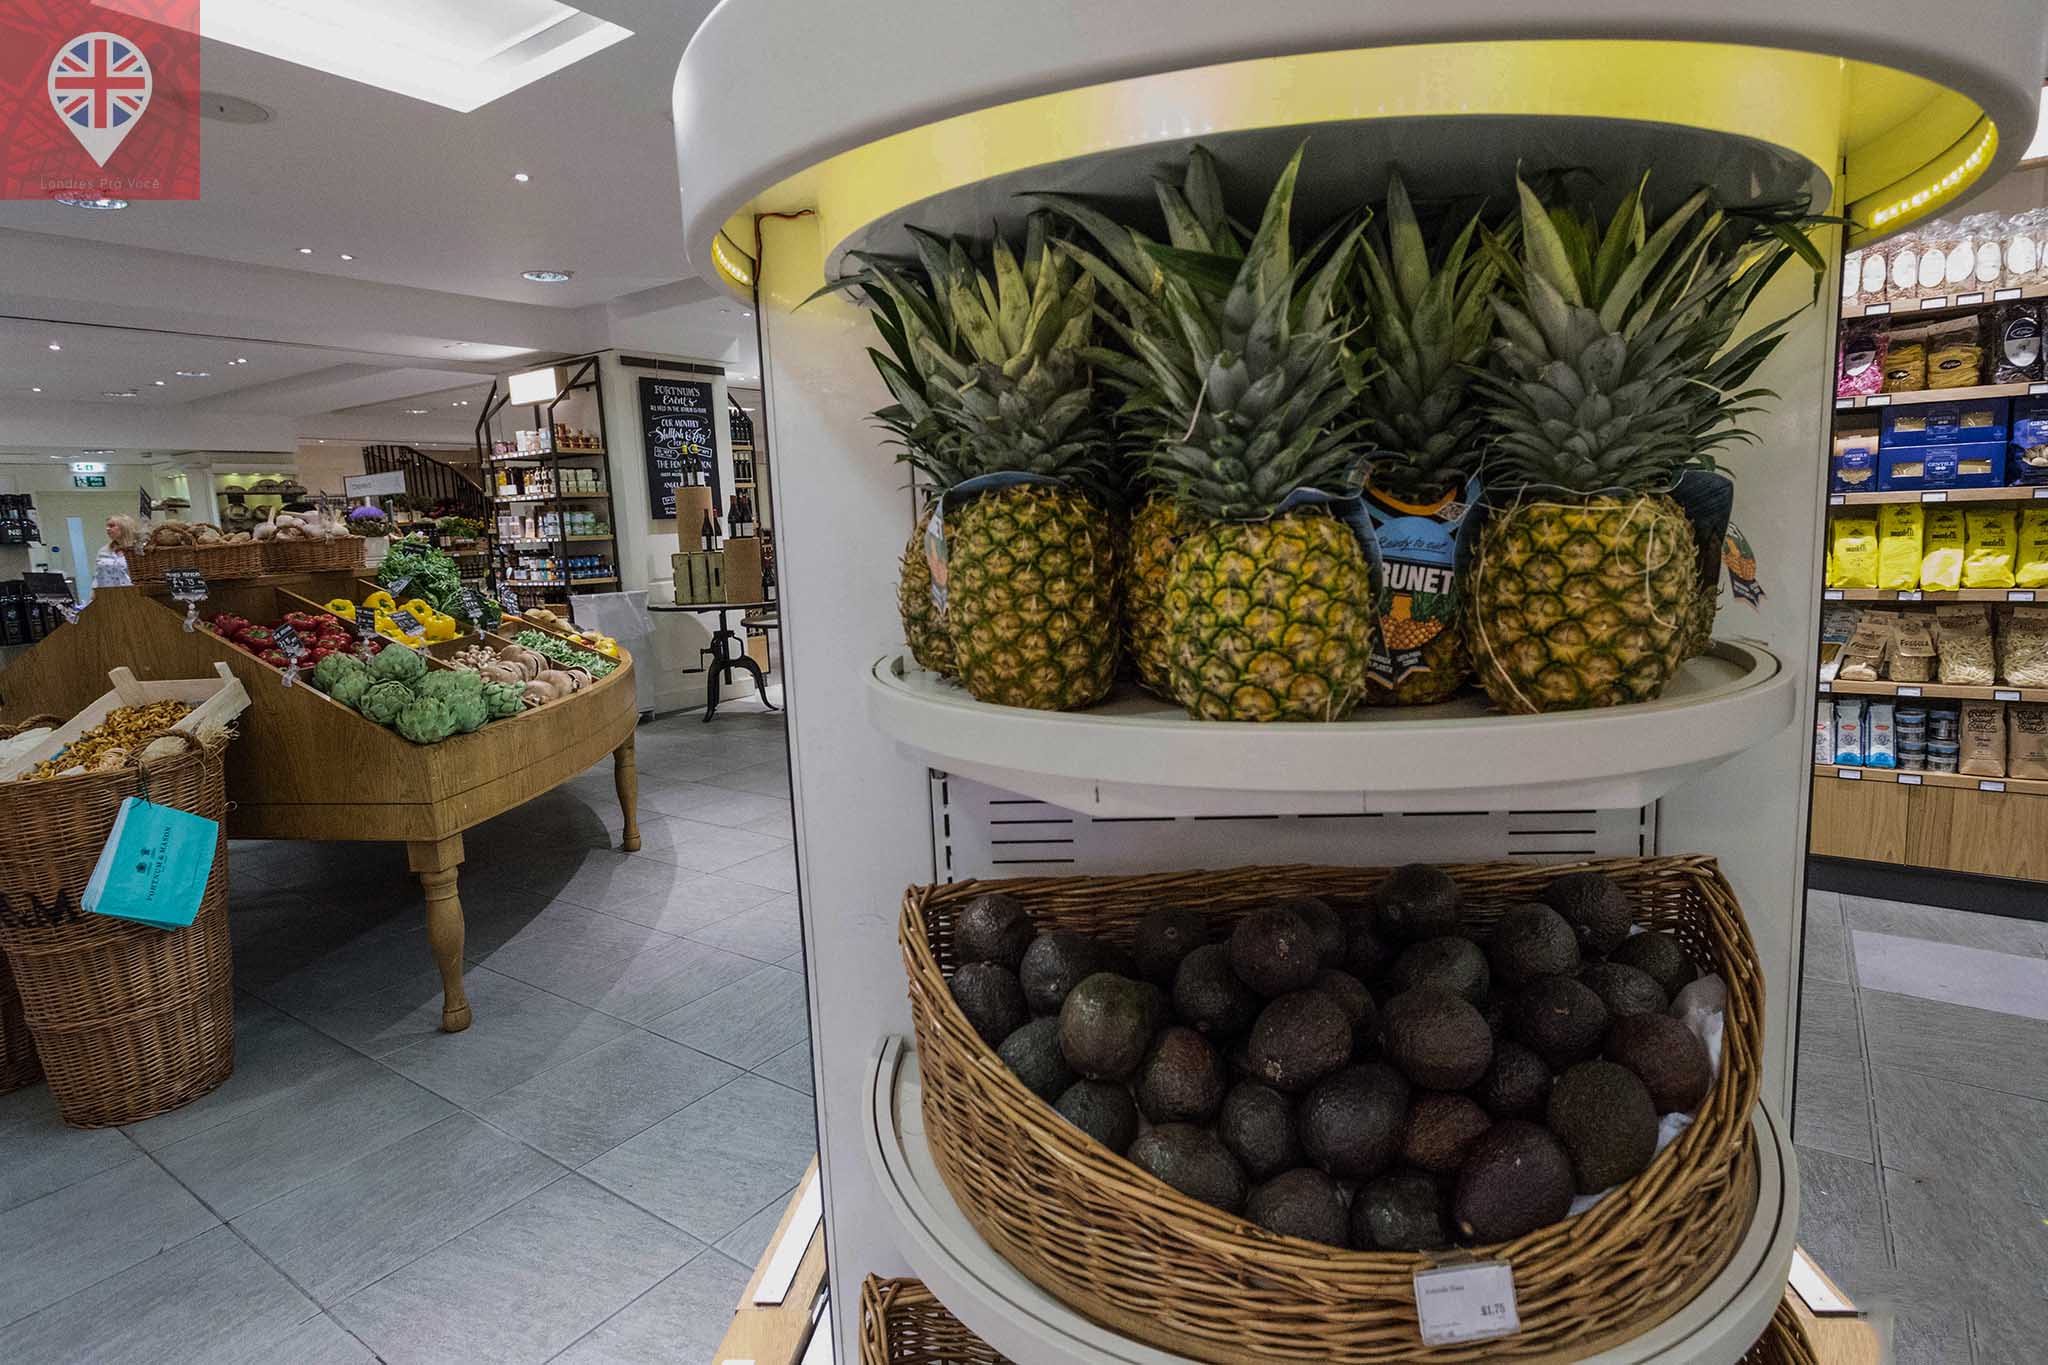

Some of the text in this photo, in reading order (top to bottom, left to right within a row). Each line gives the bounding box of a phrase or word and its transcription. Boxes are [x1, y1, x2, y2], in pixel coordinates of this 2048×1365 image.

[653, 385, 701, 397] FORTNUM'S
[662, 395, 698, 407] Events
[661, 418, 699, 428] OUR MONTHLY
[1379, 536, 1408, 552] Ready
[1413, 537, 1424, 548] to
[146, 861, 162, 901] FORTNUM
[160, 826, 172, 854] MASON
